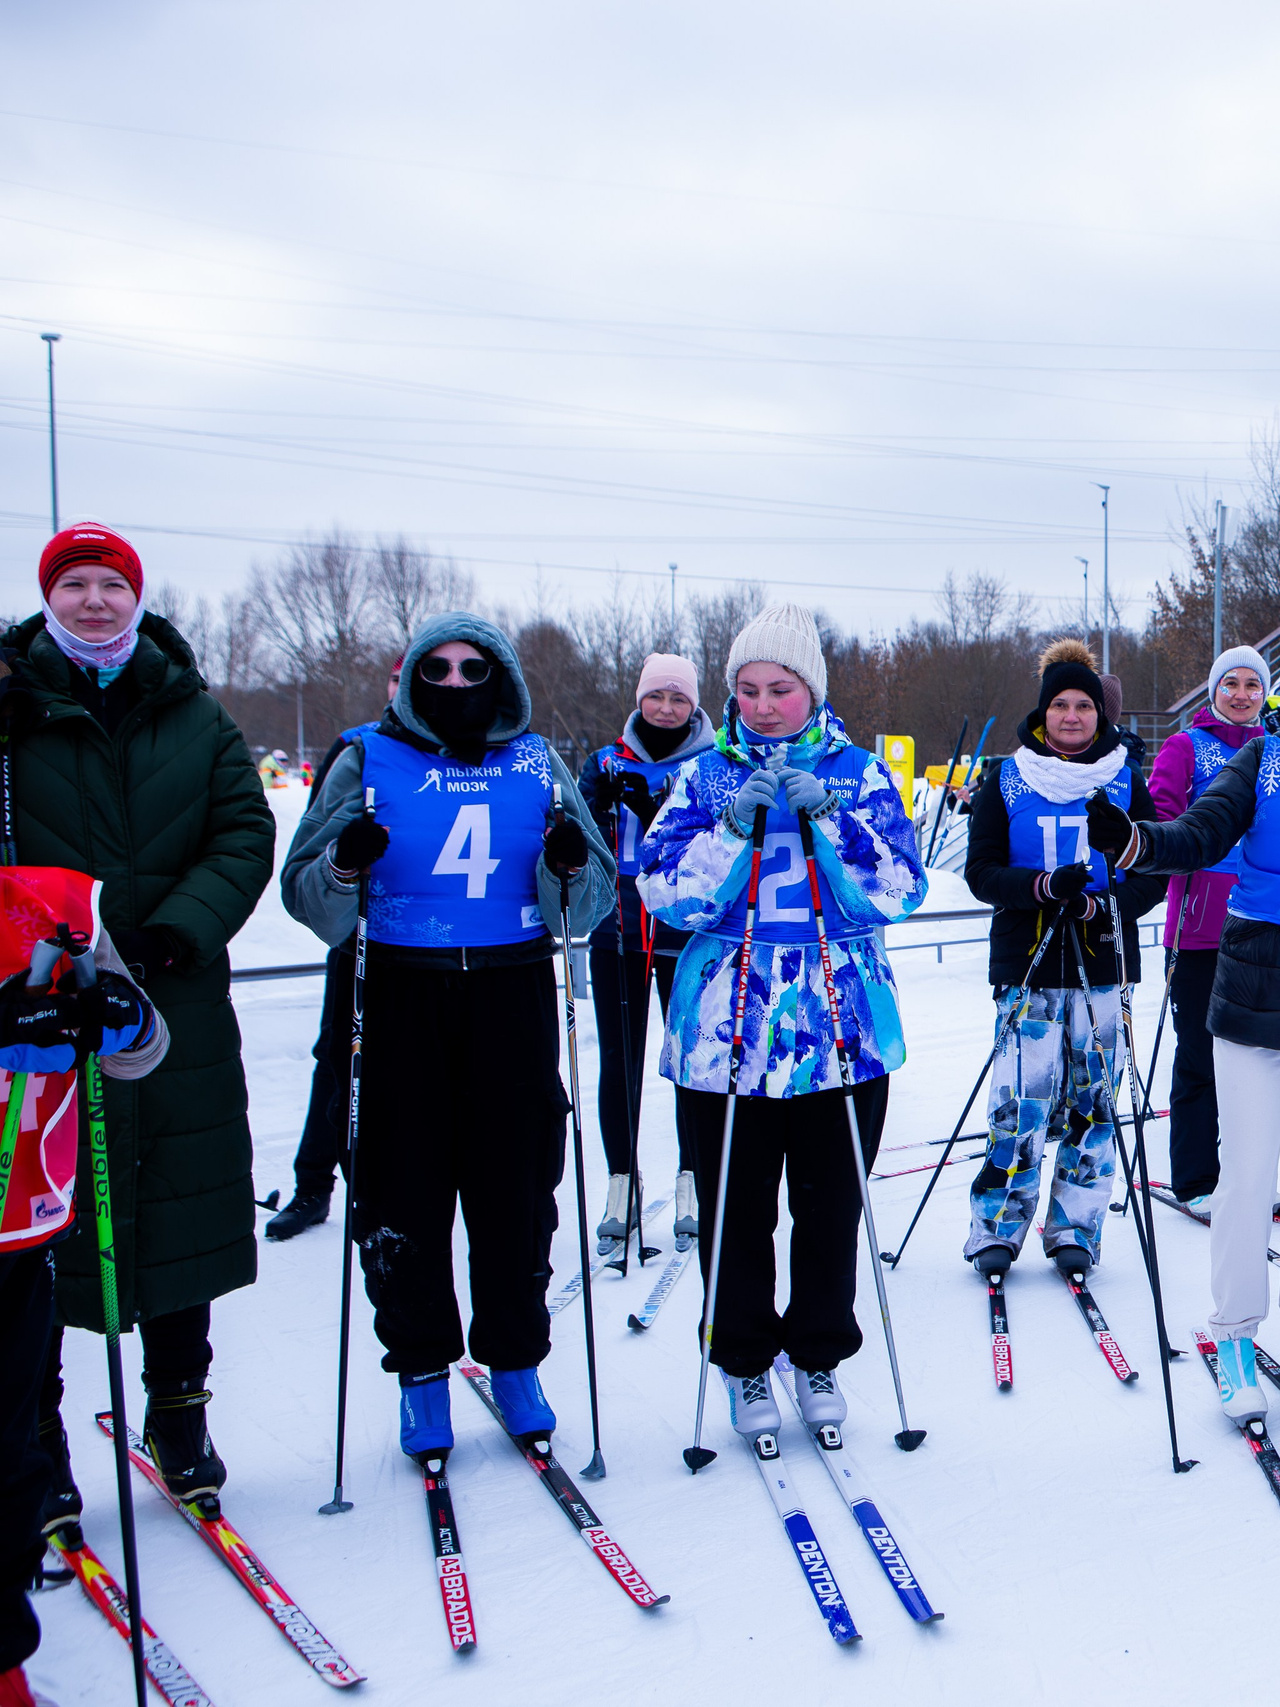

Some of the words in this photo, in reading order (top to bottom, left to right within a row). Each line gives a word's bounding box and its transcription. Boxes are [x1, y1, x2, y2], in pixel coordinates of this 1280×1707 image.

[445, 766, 502, 778] ЛЫЖНЯ
[446, 781, 490, 793] МОЭК
[828, 776, 859, 788] ЛЫЖН
[1105, 786, 1119, 796] ОЭК
[431, 803, 501, 899] 4
[758, 832, 810, 923] 2
[736, 928, 754, 1019] VUOKATTI
[818, 933, 840, 1023] VUOKATTI
[92, 1130, 110, 1219] Sable
[178, 1502, 201, 1531] ATOMIC
[438, 1527, 455, 1555] ACTIVE
[570, 1503, 596, 1527] ACTIVE
[585, 1528, 611, 1545] A3
[440, 1557, 461, 1576] A3
[598, 1543, 657, 1605] BRADOS
[797, 1540, 844, 1608] DENTON
[868, 1527, 918, 1590] DENTON
[264, 1601, 350, 1676] ATOMIC
[442, 1575, 475, 1647] BRADOS
